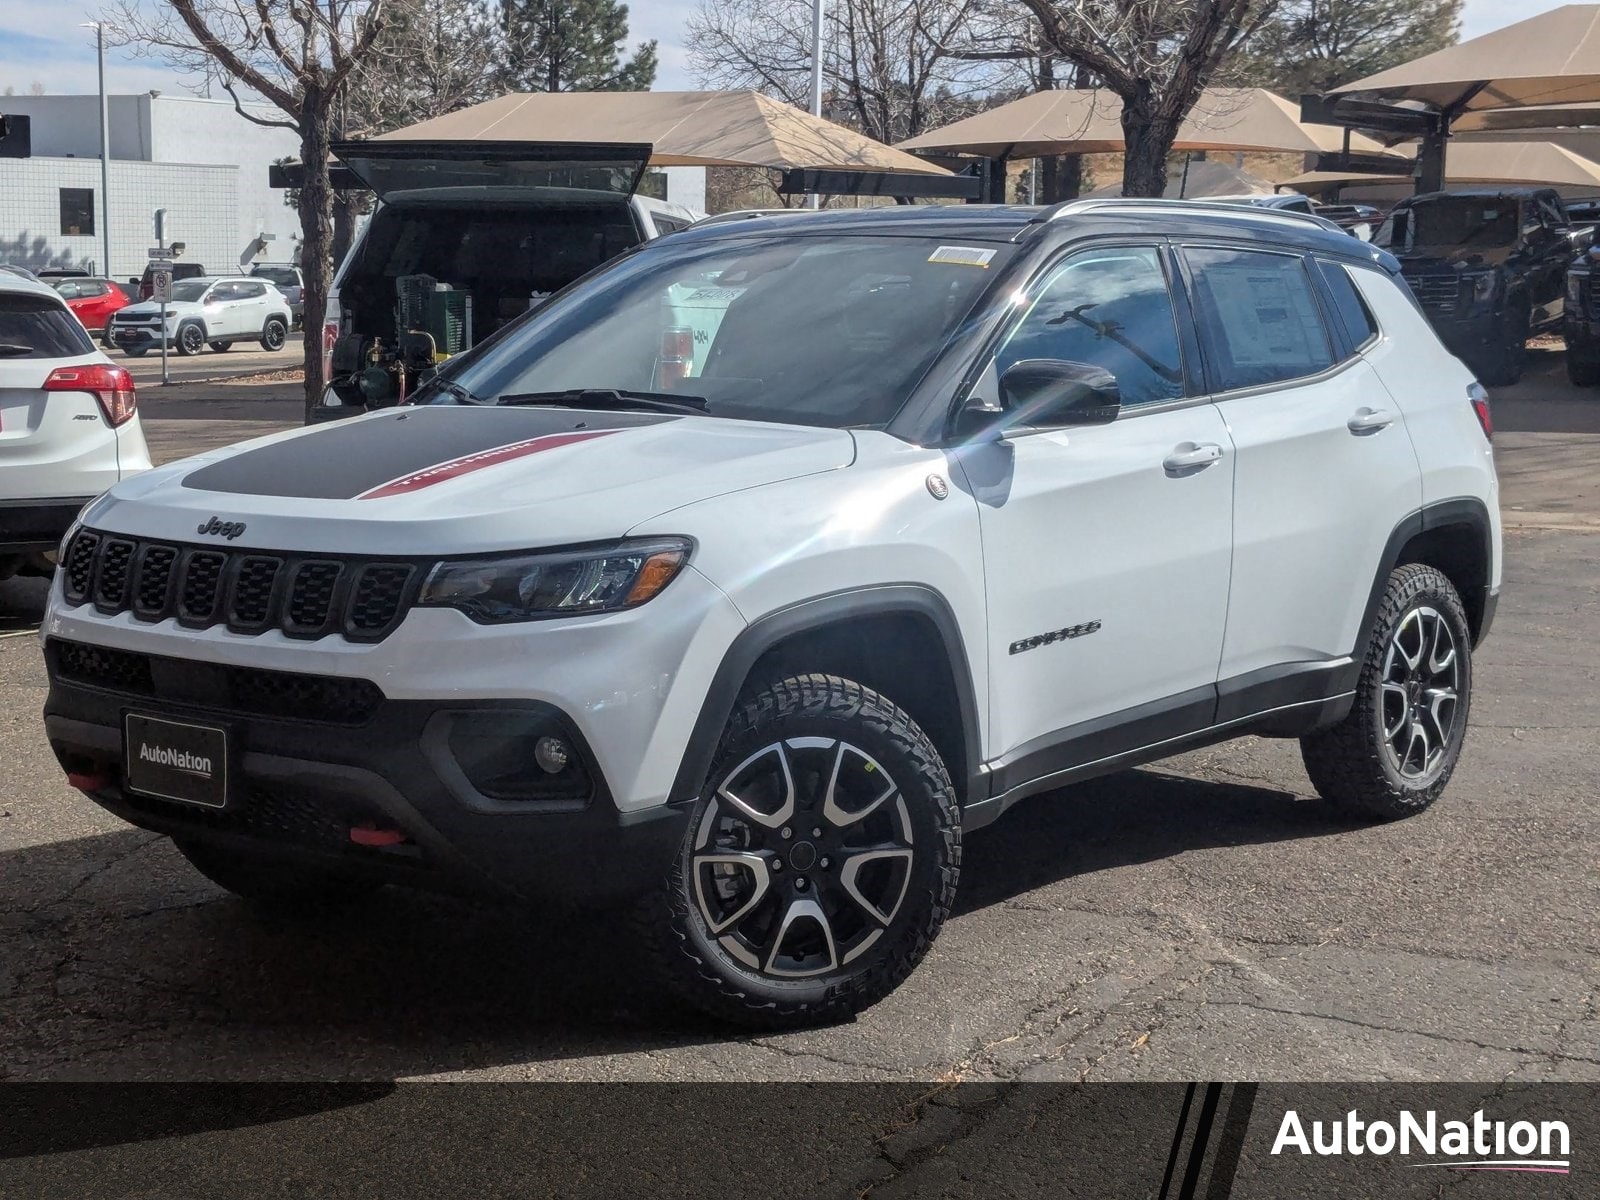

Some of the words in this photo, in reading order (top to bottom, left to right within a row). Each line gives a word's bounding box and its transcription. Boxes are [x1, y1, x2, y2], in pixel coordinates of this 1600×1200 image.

[392, 441, 537, 487] TRAILHAWK
[197, 515, 247, 541] Jeep
[1008, 618, 1102, 656] COMPASS
[139, 742, 213, 773] AutoNation
